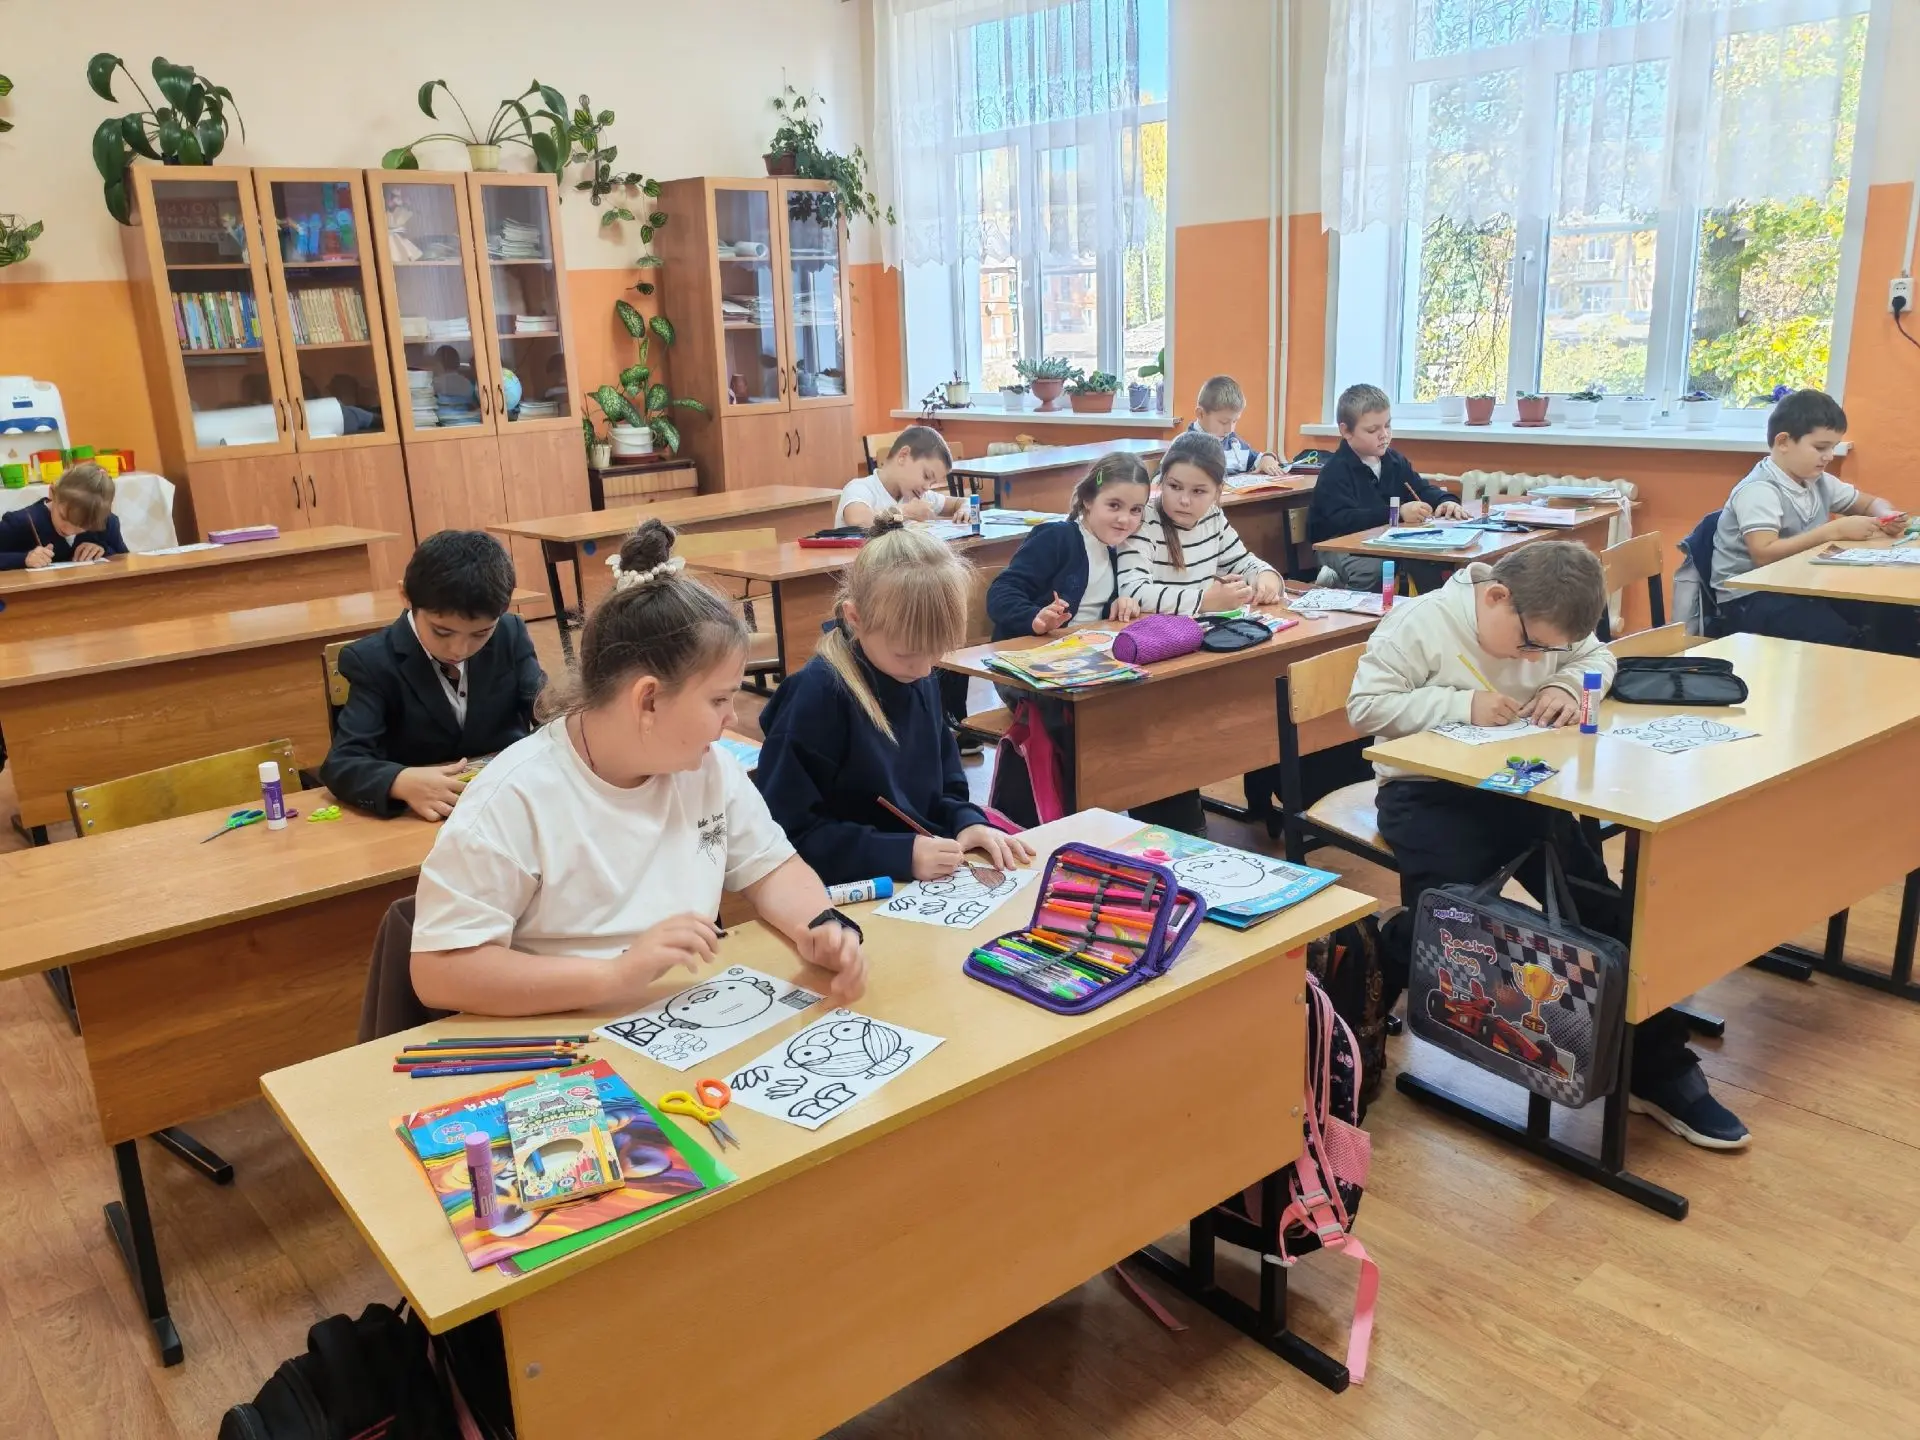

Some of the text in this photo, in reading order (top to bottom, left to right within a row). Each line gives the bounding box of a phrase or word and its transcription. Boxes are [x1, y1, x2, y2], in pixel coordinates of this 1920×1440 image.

[1440, 928, 1497, 964] Racing
[1444, 944, 1480, 976] King
[463, 1096, 505, 1112] АГА
